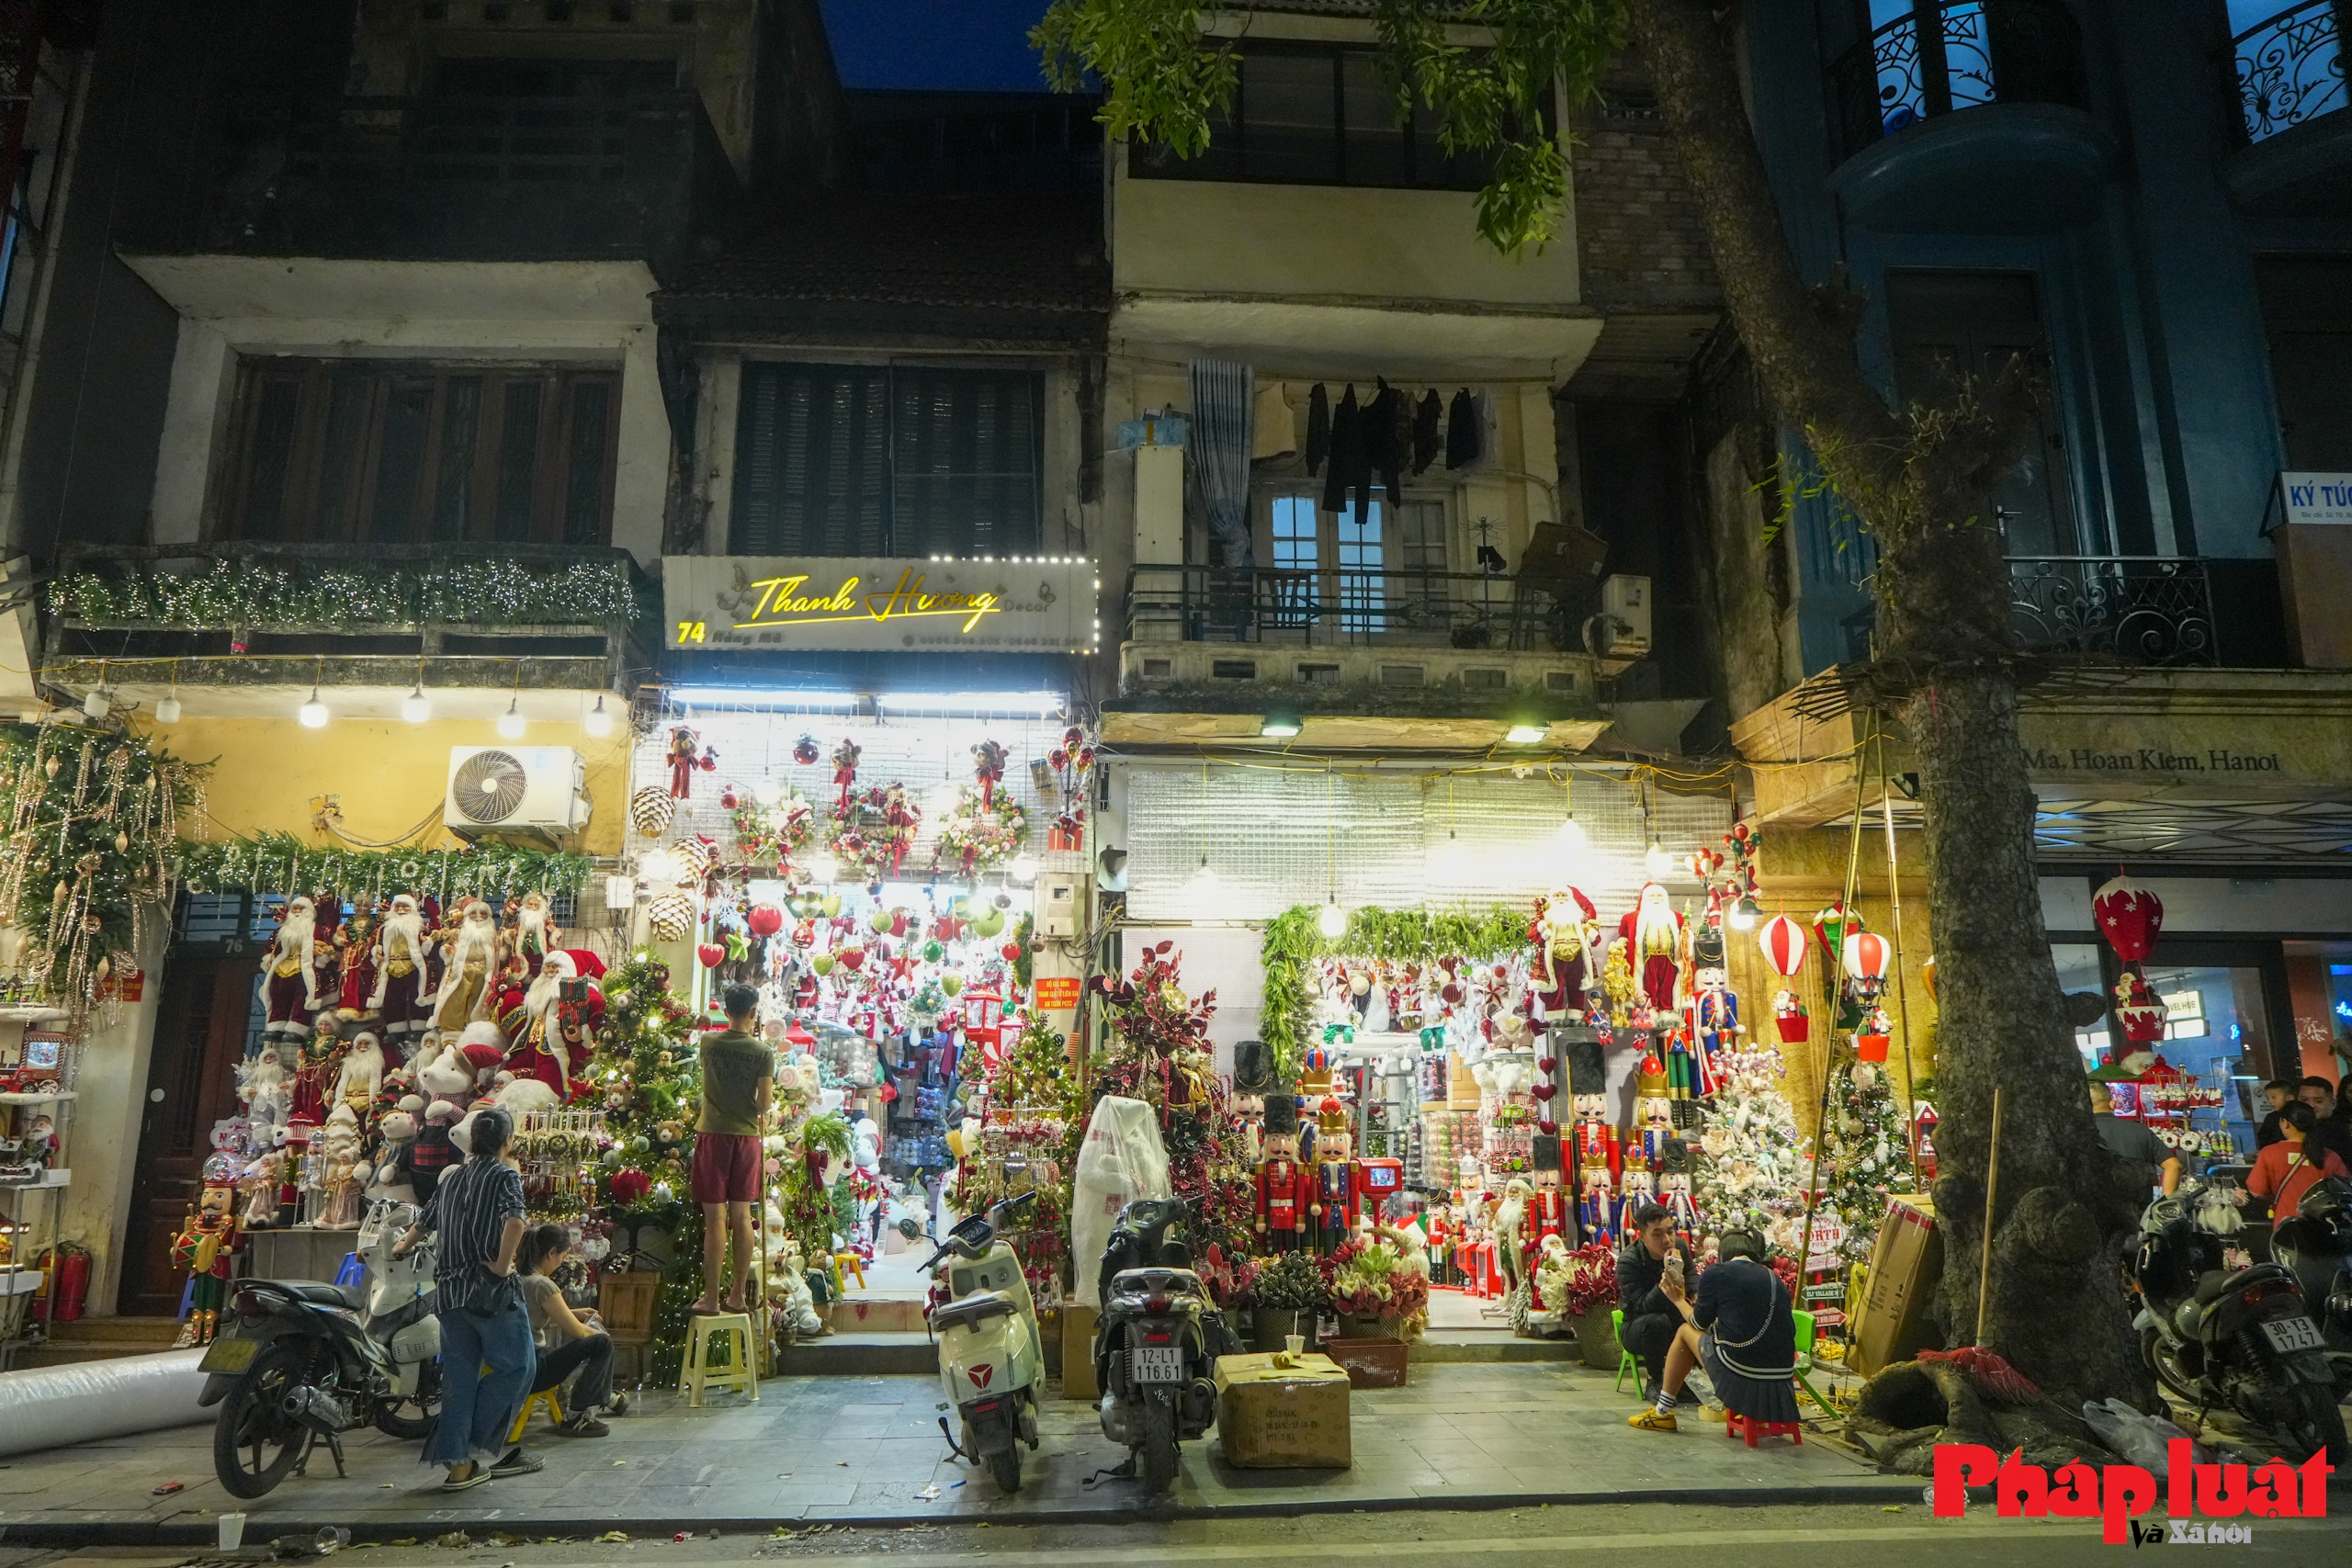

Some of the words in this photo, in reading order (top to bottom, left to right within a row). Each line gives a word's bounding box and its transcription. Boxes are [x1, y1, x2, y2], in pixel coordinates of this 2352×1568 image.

[2290, 479, 2315, 507] KÝ
[751, 575, 860, 621] Thanh
[864, 567, 1000, 634] Hương
[1004, 600, 1051, 613] Decor
[677, 621, 706, 644] 74
[2021, 749, 2067, 772] Ma,
[2070, 749, 2135, 771] Hoan
[2138, 749, 2205, 773] Kiem,
[2208, 750, 2280, 772] Hanoi
[224, 938, 243, 953] 76
[2182, 1000, 2197, 1010] HUB
[2268, 1318, 2310, 1337] 30-Y3
[2278, 1331, 2315, 1349] 1747
[1141, 1348, 1174, 1364] 12-L1
[1136, 1365, 1180, 1380] 116.61
